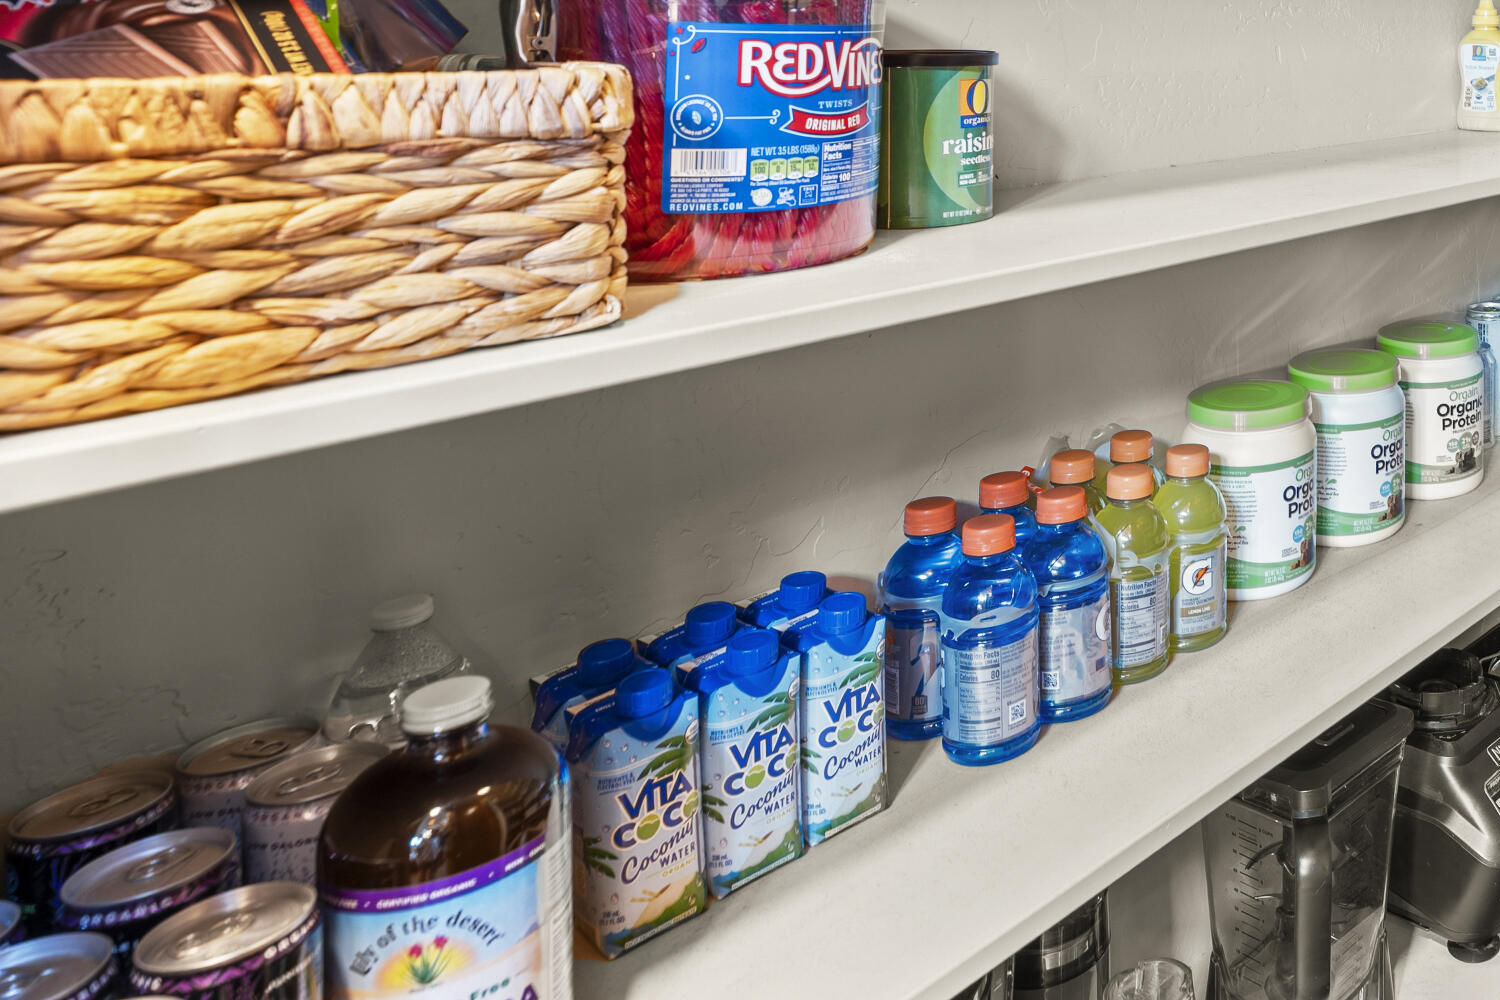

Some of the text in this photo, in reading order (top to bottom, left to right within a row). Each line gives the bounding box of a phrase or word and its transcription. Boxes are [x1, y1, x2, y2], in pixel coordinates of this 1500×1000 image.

[818, 99, 853, 110] TWISTS
[805, 114, 861, 132] ORIGINAL RED
[750, 146, 763, 157] NET
[787, 145, 800, 155] LBS
[823, 152, 843, 161] Facts
[824, 142, 852, 151] Nutrition
[839, 172, 851, 182] 100
[669, 202, 743, 211] REDVINES.COM
[1442, 410, 1482, 431] Protein
[1121, 582, 1144, 592] Nutrition
[1182, 557, 1214, 596] G
[983, 650, 1000, 659] Facts
[990, 669, 1000, 680] 80
[822, 682, 881, 724] VITA
[728, 725, 795, 769] VITA
[823, 717, 884, 780] Coconut
[854, 745, 882, 768] WATER
[616, 770, 693, 821] VITA
[729, 762, 797, 831] Coconut
[763, 791, 796, 816] WATER
[620, 810, 698, 885] Coconut
[659, 840, 696, 869] WATER
[376, 922, 398, 949] of
[401, 914, 440, 935] the
[446, 909, 506, 947] desert
[469, 978, 511, 1000] Free
